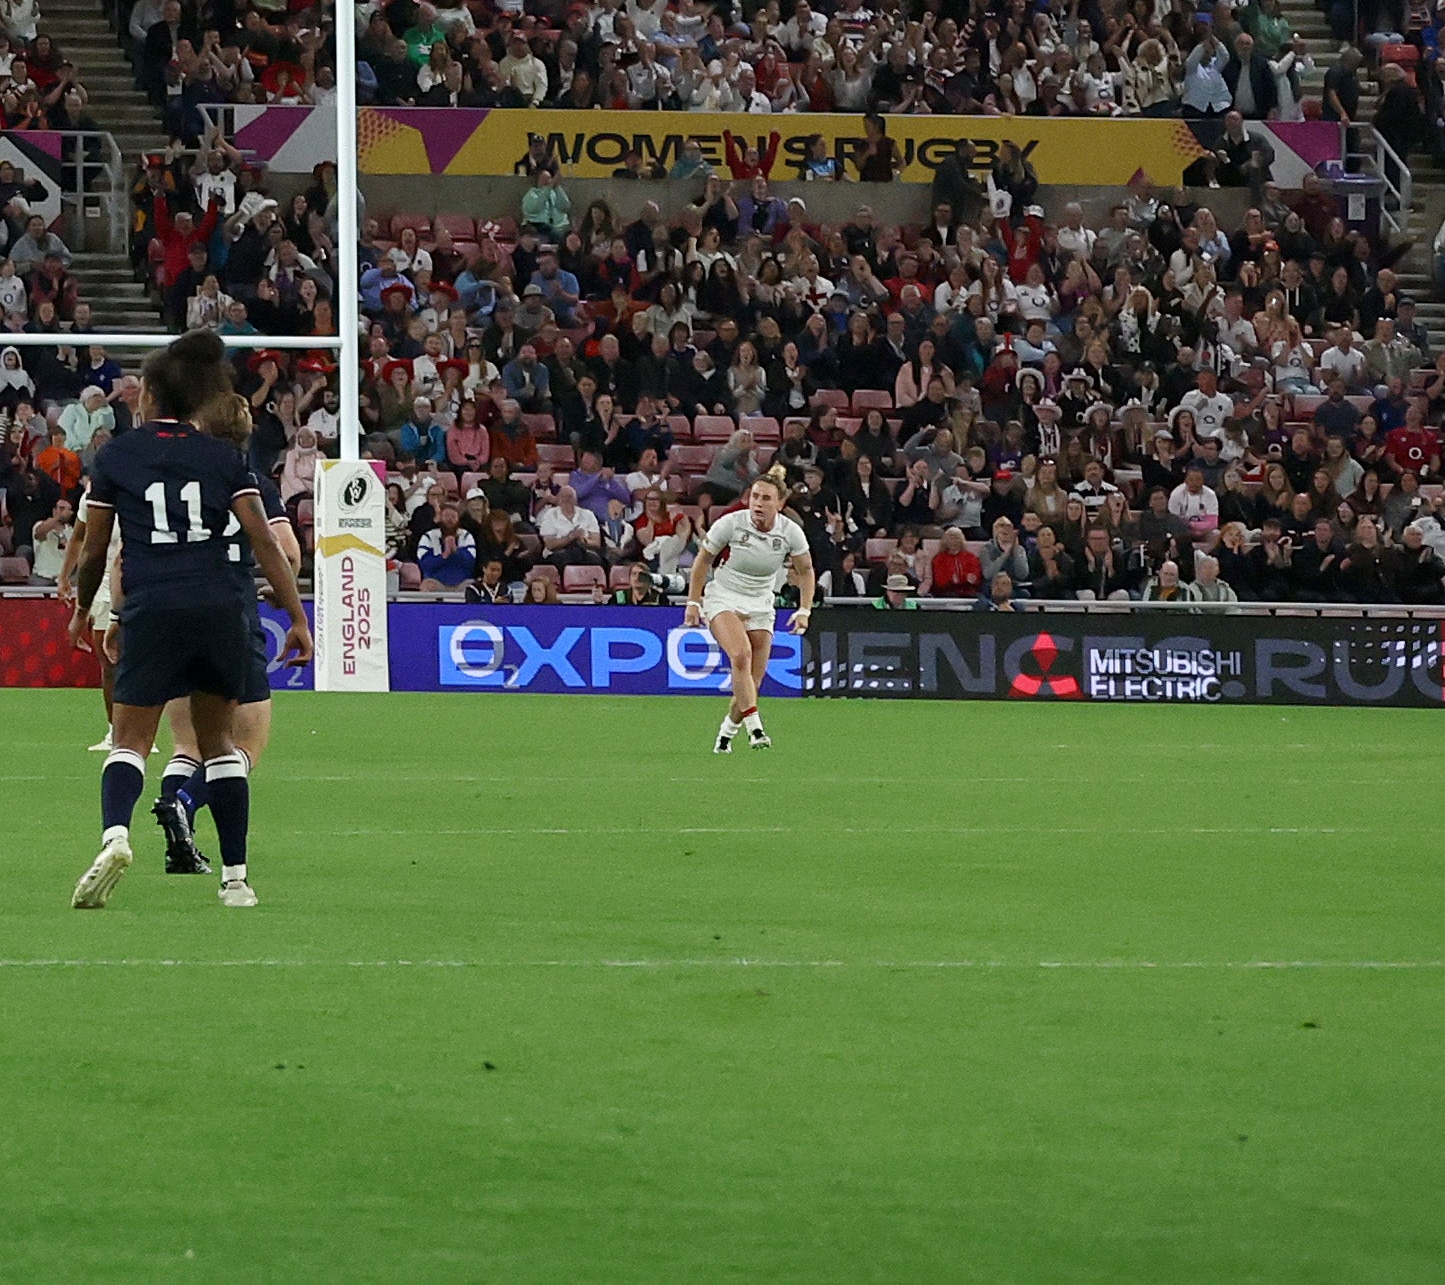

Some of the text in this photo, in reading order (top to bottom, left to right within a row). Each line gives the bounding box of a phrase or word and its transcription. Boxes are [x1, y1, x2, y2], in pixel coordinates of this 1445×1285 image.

[144, 480, 212, 545] 11
[342, 556, 356, 676] ENGLAND
[358, 587, 371, 650] 2025
[1089, 647, 1241, 676] MITSUBISHI
[1090, 674, 1223, 701] ELECTRIC
